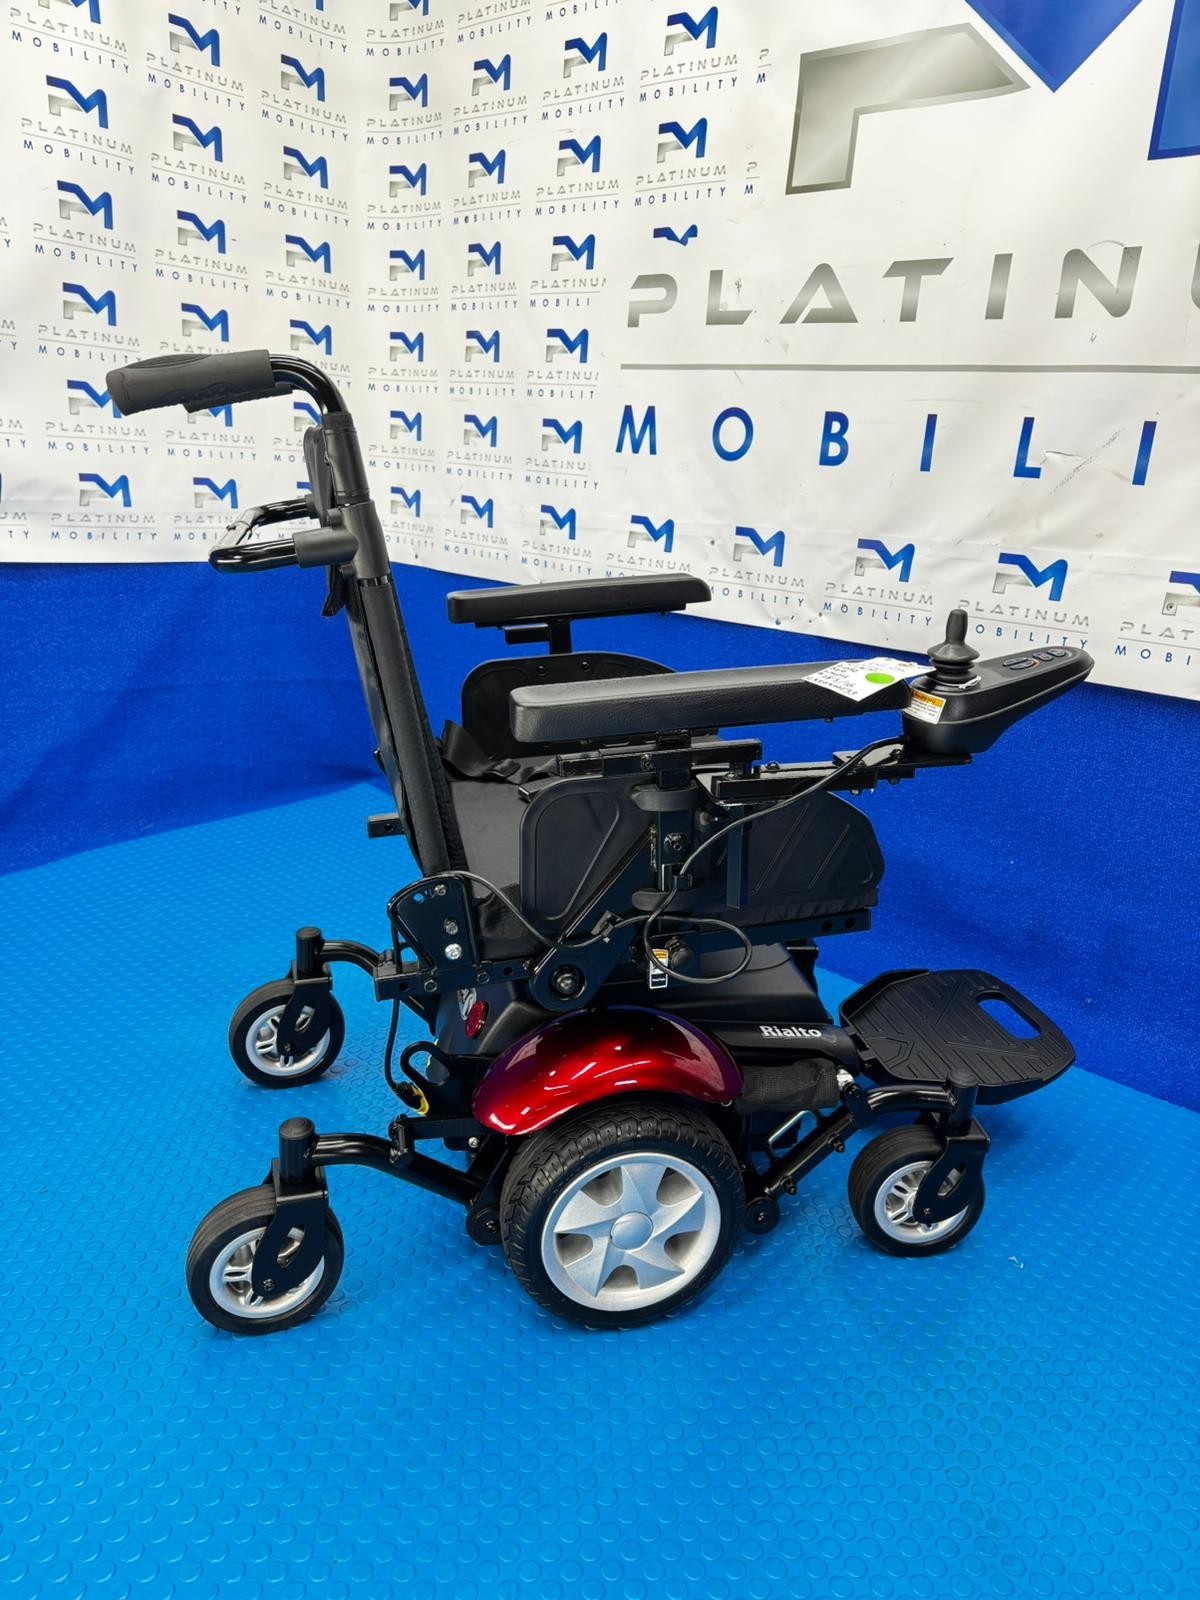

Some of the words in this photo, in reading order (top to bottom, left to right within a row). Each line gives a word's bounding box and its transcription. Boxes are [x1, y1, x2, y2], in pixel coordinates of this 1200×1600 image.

[10, 7, 127, 53] PLATINUM
[259, 15, 347, 52] MOBILITY
[366, 19, 444, 38] PLATINUM
[458, 16, 531, 42] MOBILITY
[12, 30, 128, 73] MOBILITY
[366, 38, 444, 56] MOBILITY
[146, 52, 243, 92] PLATINUM
[640, 54, 738, 81] PLATINUM
[148, 73, 244, 110] MOBILITY
[543, 76, 624, 101] PLATINUM
[640, 77, 737, 102] MOBILITY
[261, 90, 347, 124] PLATINUM
[453, 95, 527, 117] PLATINUM
[542, 97, 624, 120] MOBILITY
[262, 109, 348, 141] MOBILITY
[366, 112, 442, 128] PLATINUM
[454, 115, 527, 135] MOBILITY
[21, 117, 133, 155] PLATINUM
[367, 131, 442, 145] MOBILITY
[24, 140, 134, 175] MOBILITY
[151, 152, 245, 185] PLATINUM
[636, 165, 726, 186] PLATINUM
[152, 173, 246, 203] MOBILITY
[264, 182, 348, 210] PLATINUM
[536, 179, 619, 197] PLATINUM
[635, 187, 726, 206] MOBILITY
[367, 198, 441, 214] PLATINUM
[453, 190, 520, 207] PLATINUM
[535, 200, 619, 215] MOBILITY
[264, 201, 349, 226] MOBILITY
[453, 209, 521, 224] MOBILITY
[367, 219, 441, 230] MOBILITY
[33, 223, 136, 253] PLATINUM
[35, 244, 137, 272] MOBILITY
[154, 249, 247, 274] PLATINUM
[156, 269, 248, 292] MOBILITY
[266, 270, 351, 293] PLATINUM
[451, 281, 517, 294] PLATINUM
[627, 244, 1200, 328] PLATIN
[267, 288, 350, 308] MOBILITY
[368, 286, 439, 296] PLATINUM
[368, 304, 439, 312] MOBILITY
[451, 300, 517, 310] MOBILITY
[38, 324, 140, 347] PLATINUM
[368, 367, 438, 377] PLATINUM
[449, 369, 515, 379] PLATINUM
[368, 384, 437, 393] MOBILITY
[450, 387, 514, 396] MOBILITY
[45, 422, 147, 437] PLATINUM
[166, 430, 255, 444] PLATINUM
[48, 442, 148, 454] MOBILITY
[168, 448, 256, 460] MOBILITY
[369, 445, 435, 456] PLATINUM
[370, 461, 435, 472] MOBILITY
[447, 451, 512, 464] PLATINUM
[447, 468, 512, 480] MOBILITY
[526, 476, 598, 489] MOBILITY
[51, 512, 155, 523] PLATINUM
[51, 531, 157, 540] MOBILITY
[382, 519, 434, 535] LATINUM
[386, 535, 434, 547] OBILITY
[445, 529, 508, 545] PLATINUM
[445, 545, 508, 560] MOBILITY
[522, 540, 591, 558] PLATINUM
[521, 557, 591, 574] MOBILITY
[606, 553, 690, 571] PLATINUM
[709, 567, 804, 588] PLATINUM
[825, 582, 933, 605] PLATINUM
[823, 602, 931, 626] MOBILITY
[759, 1025, 822, 1038] Rialto
